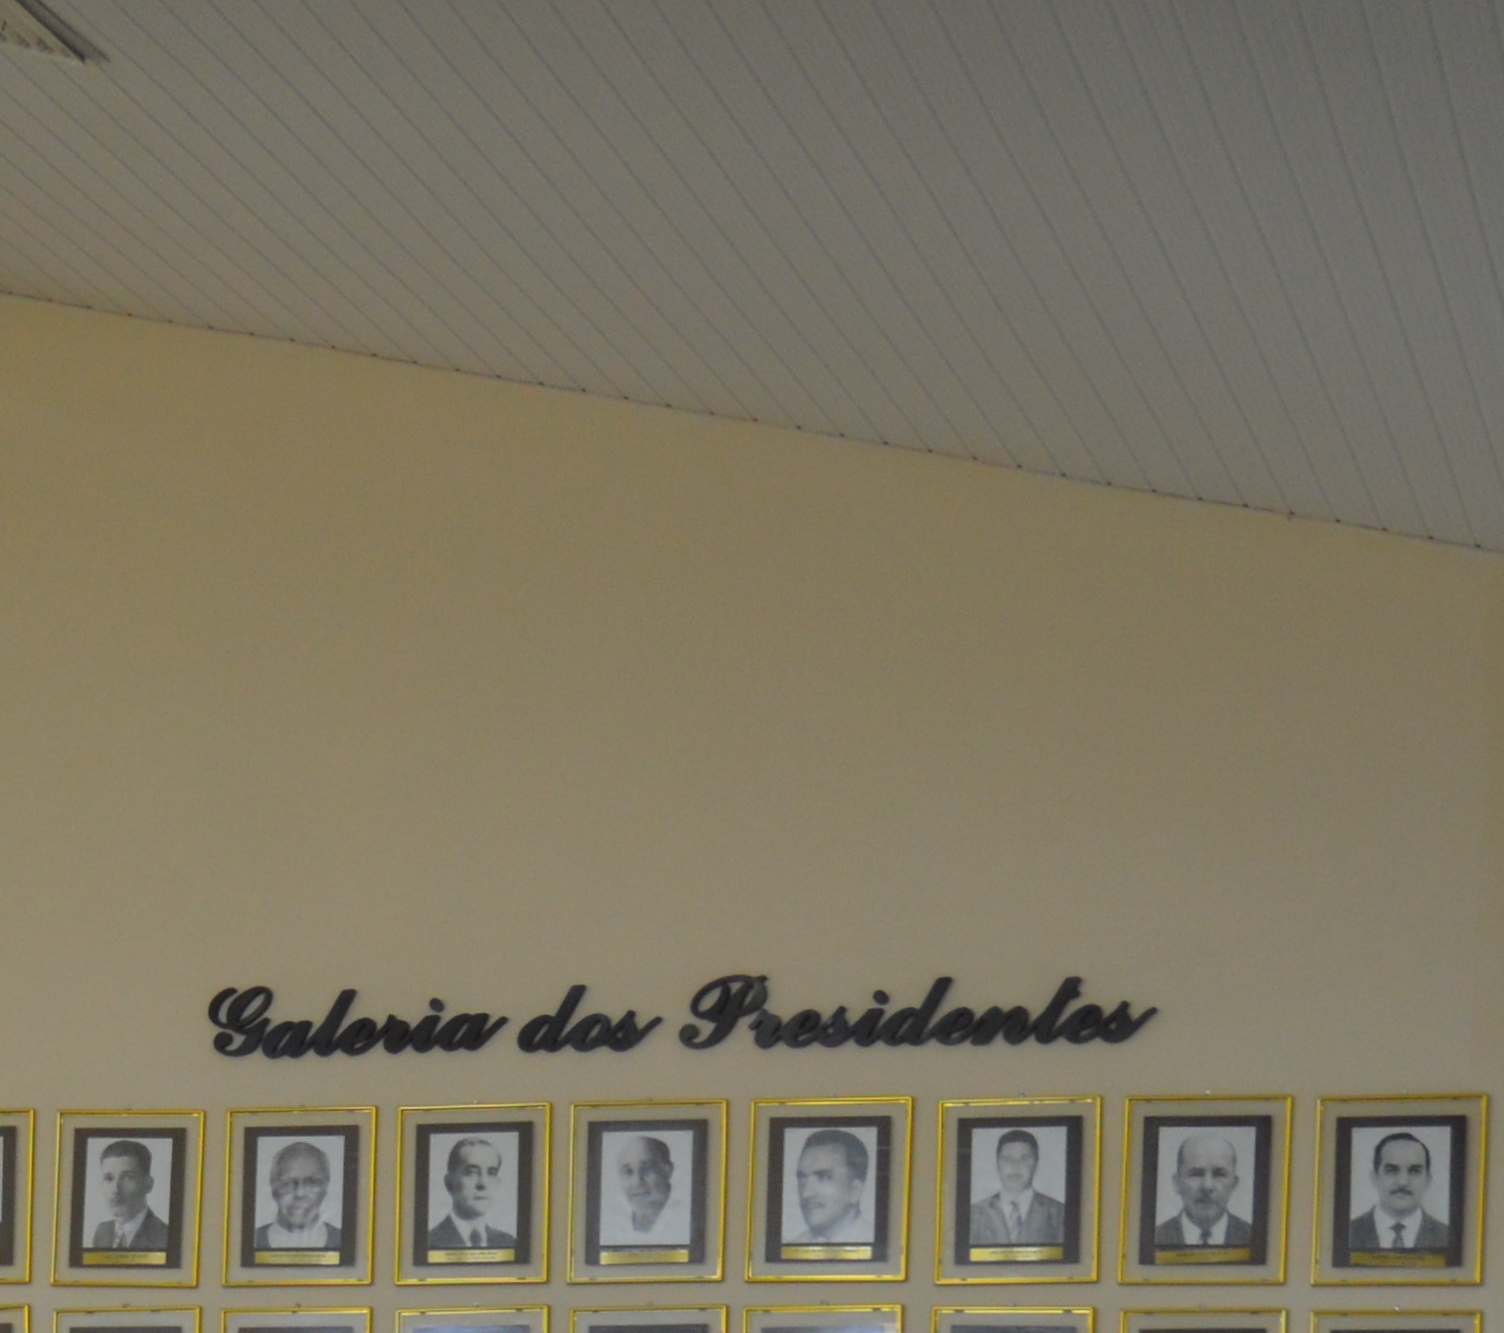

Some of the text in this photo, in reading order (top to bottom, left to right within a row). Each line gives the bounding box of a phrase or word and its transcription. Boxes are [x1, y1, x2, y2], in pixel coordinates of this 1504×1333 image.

[208, 974, 1158, 1059] Galeria dos Presidentes
